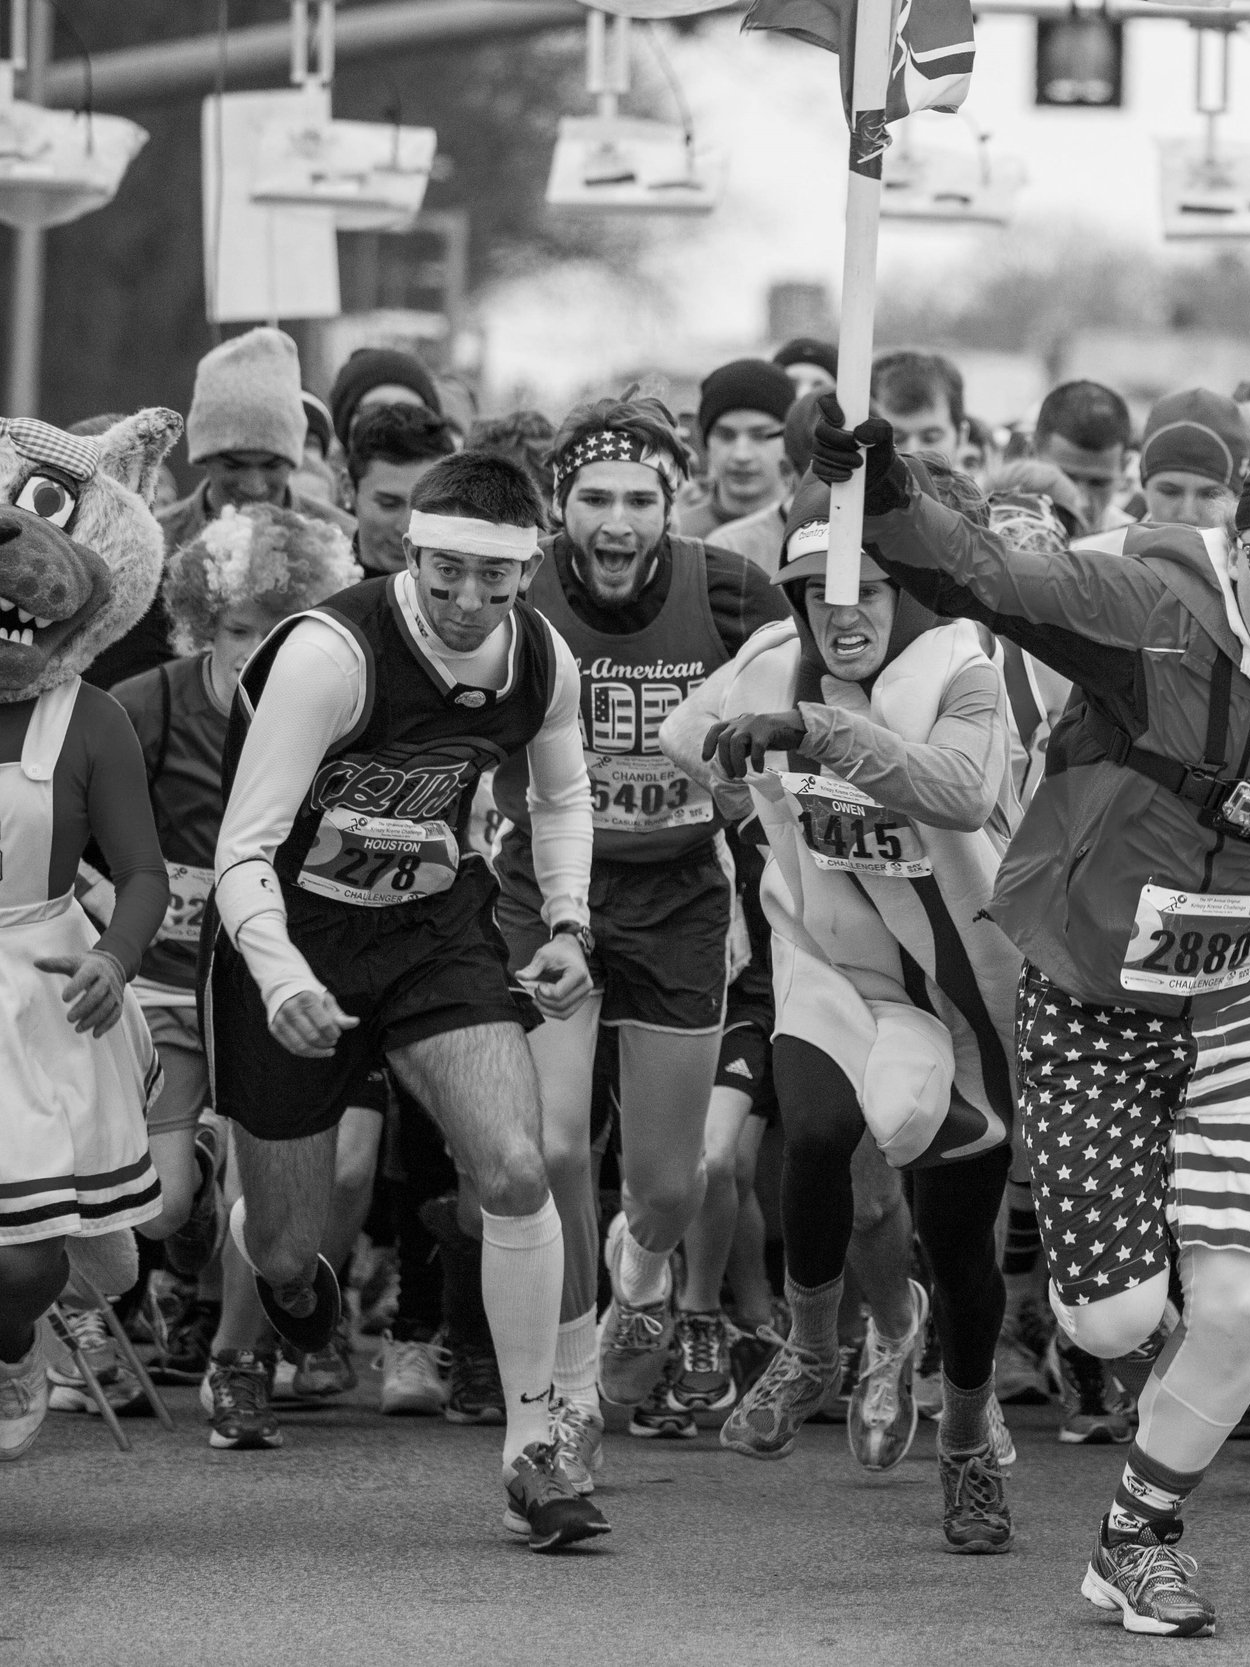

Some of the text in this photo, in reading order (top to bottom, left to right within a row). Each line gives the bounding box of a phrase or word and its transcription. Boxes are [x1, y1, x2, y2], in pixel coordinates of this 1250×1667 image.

[612, 771, 675, 783] CHANDLER
[590, 778, 689, 816] 5403
[831, 800, 866, 817] OWEN
[798, 811, 902, 860] 1415
[364, 838, 421, 853] HOUSTON
[334, 848, 422, 891] 278
[827, 859, 887, 871] CHALLENGER
[344, 890, 403, 903] CHALLENGER
[1223, 903, 1246, 911] Challenge
[1168, 977, 1225, 989] CHALLENGER
